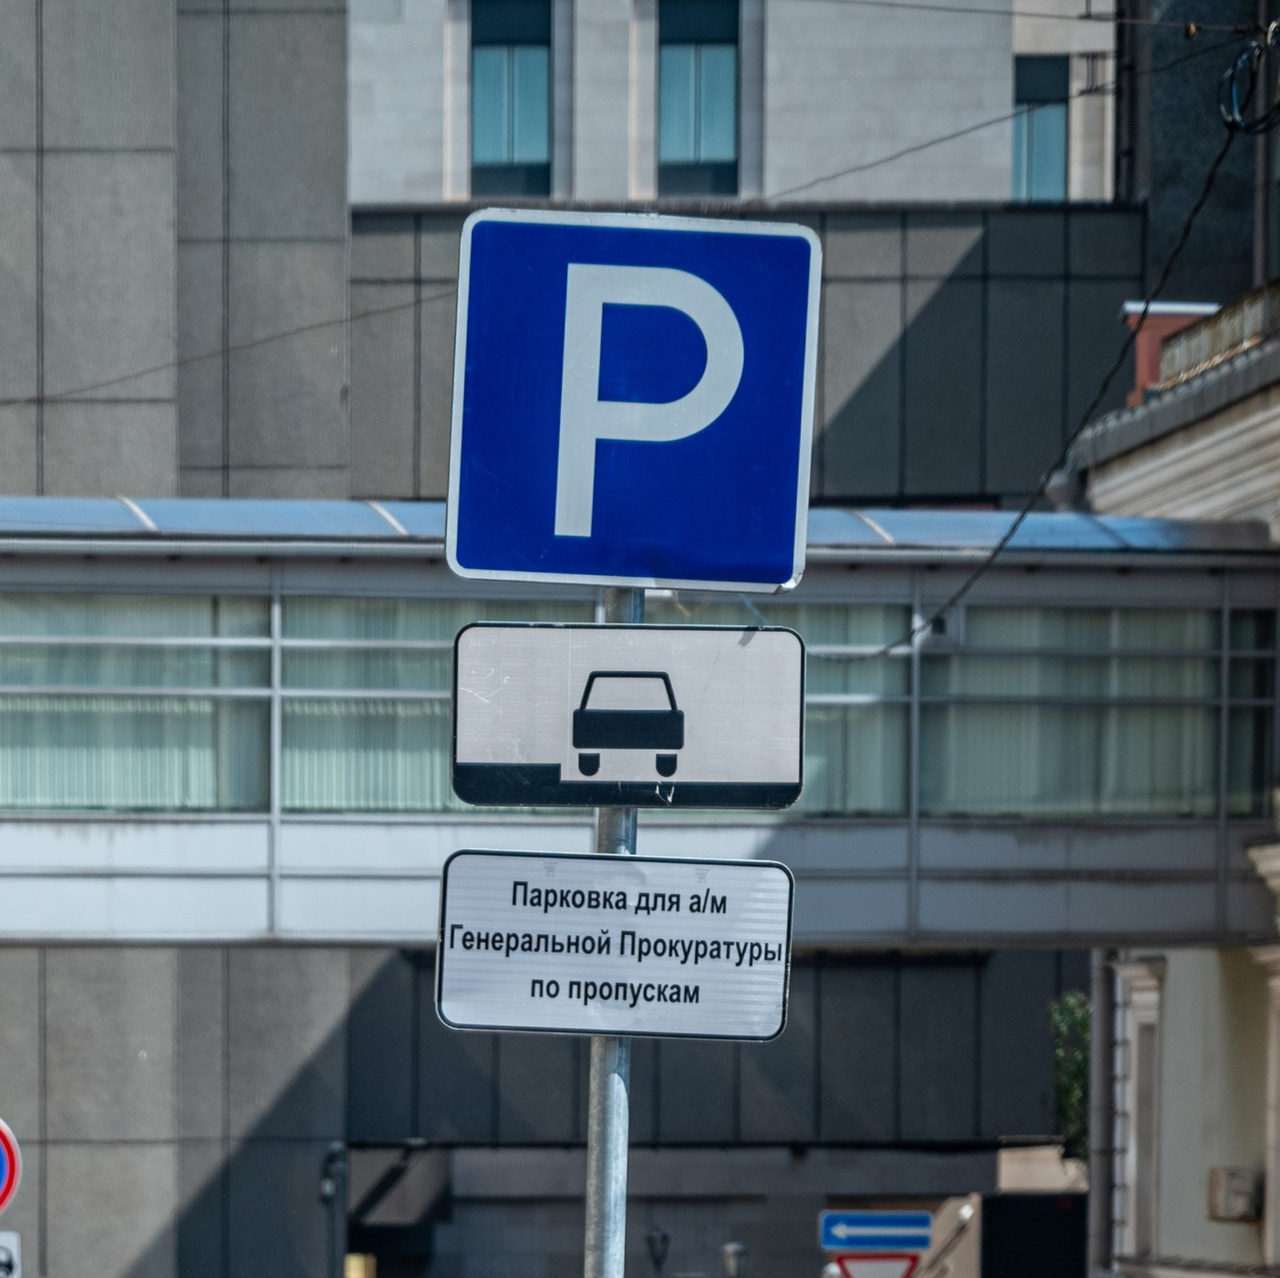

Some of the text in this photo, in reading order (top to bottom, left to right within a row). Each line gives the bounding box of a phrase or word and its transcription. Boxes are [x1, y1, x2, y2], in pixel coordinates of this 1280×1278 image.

[554, 262, 745, 538] P
[511, 881, 728, 915] Парковка для а/м
[449, 924, 783, 967] Генеральной Прокуратуры
[530, 978, 701, 1008] по пропускам
